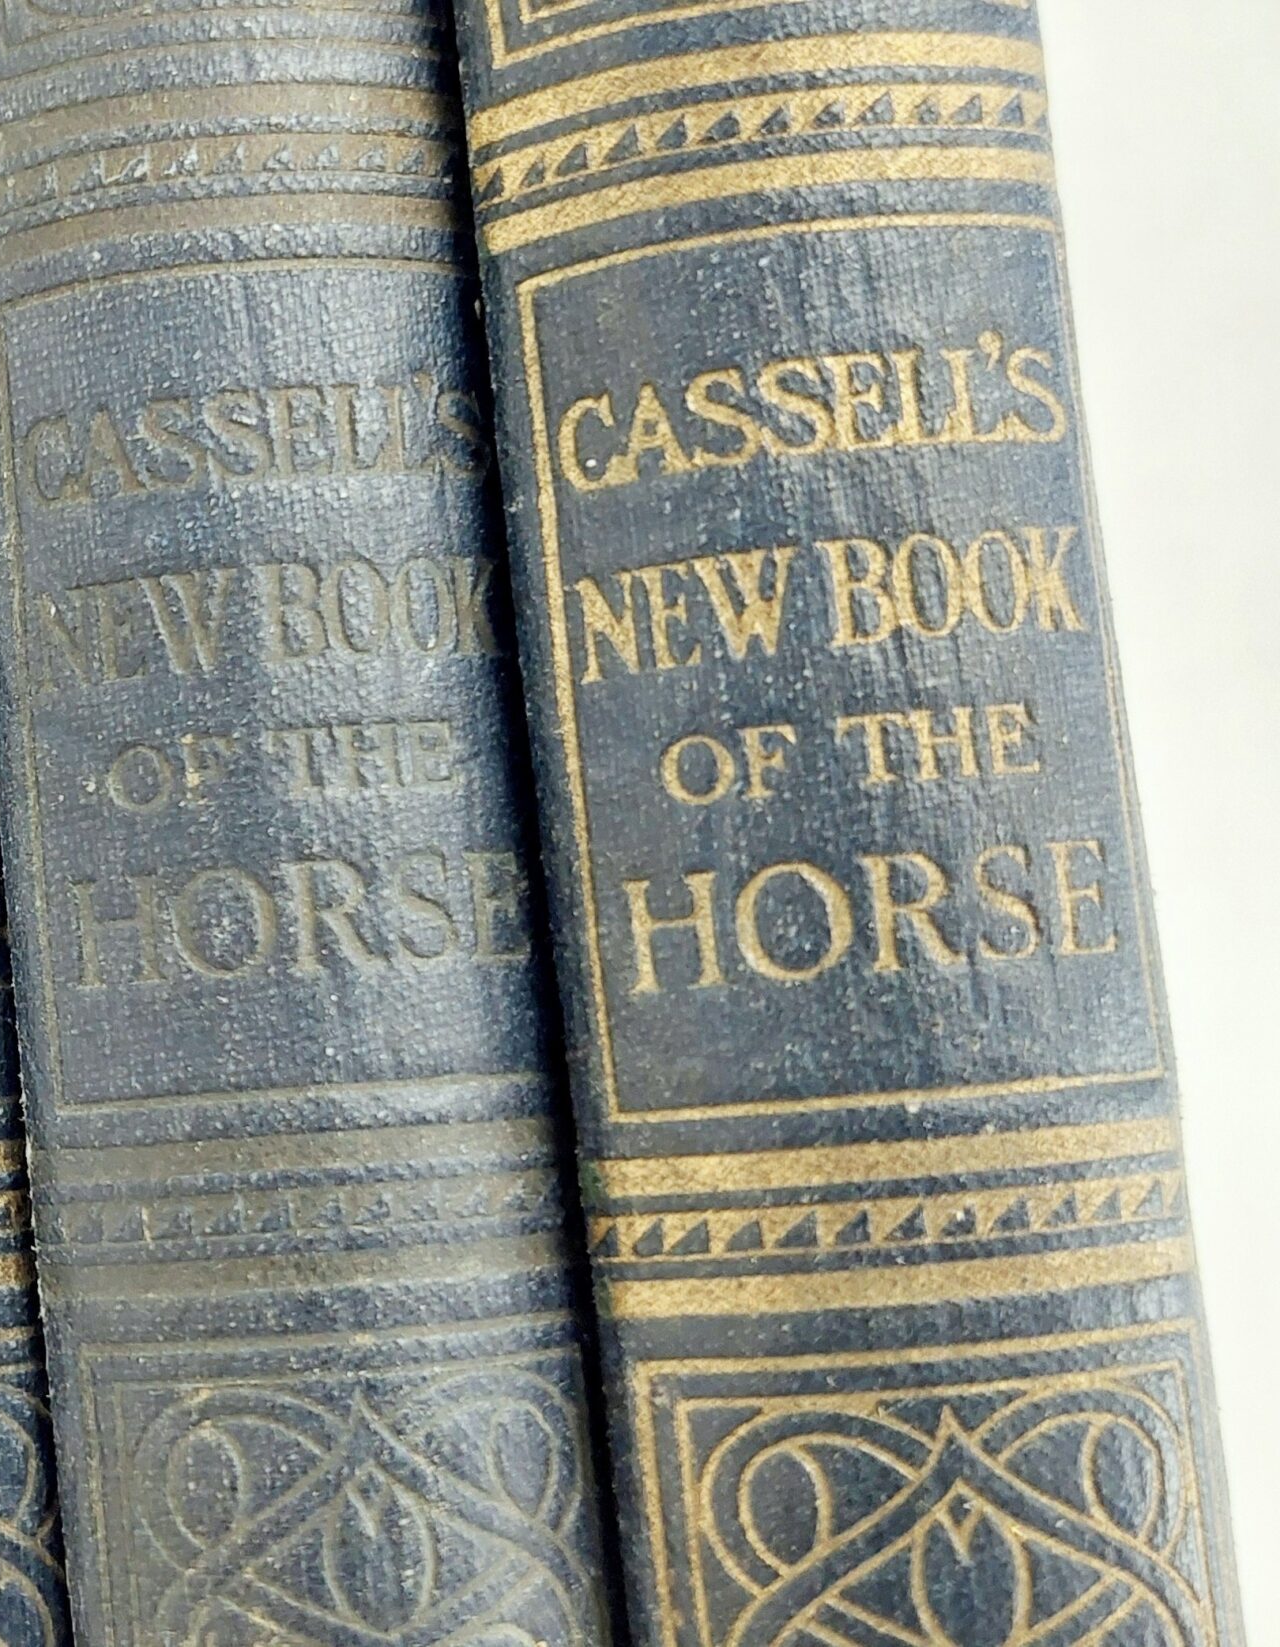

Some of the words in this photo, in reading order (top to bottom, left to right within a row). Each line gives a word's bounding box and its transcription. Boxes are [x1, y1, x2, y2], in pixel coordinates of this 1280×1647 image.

[558, 331, 1070, 493] CASSELL'S
[30, 567, 238, 695] NEW
[249, 555, 502, 665] BOOK
[572, 546, 797, 685] NEW
[816, 526, 1091, 649] BOOK
[108, 733, 238, 814] OF
[269, 720, 462, 793] THE
[660, 725, 797, 805] OF
[835, 702, 1041, 787] THE
[70, 852, 530, 989] HORSE
[622, 839, 1119, 995] HORSE
